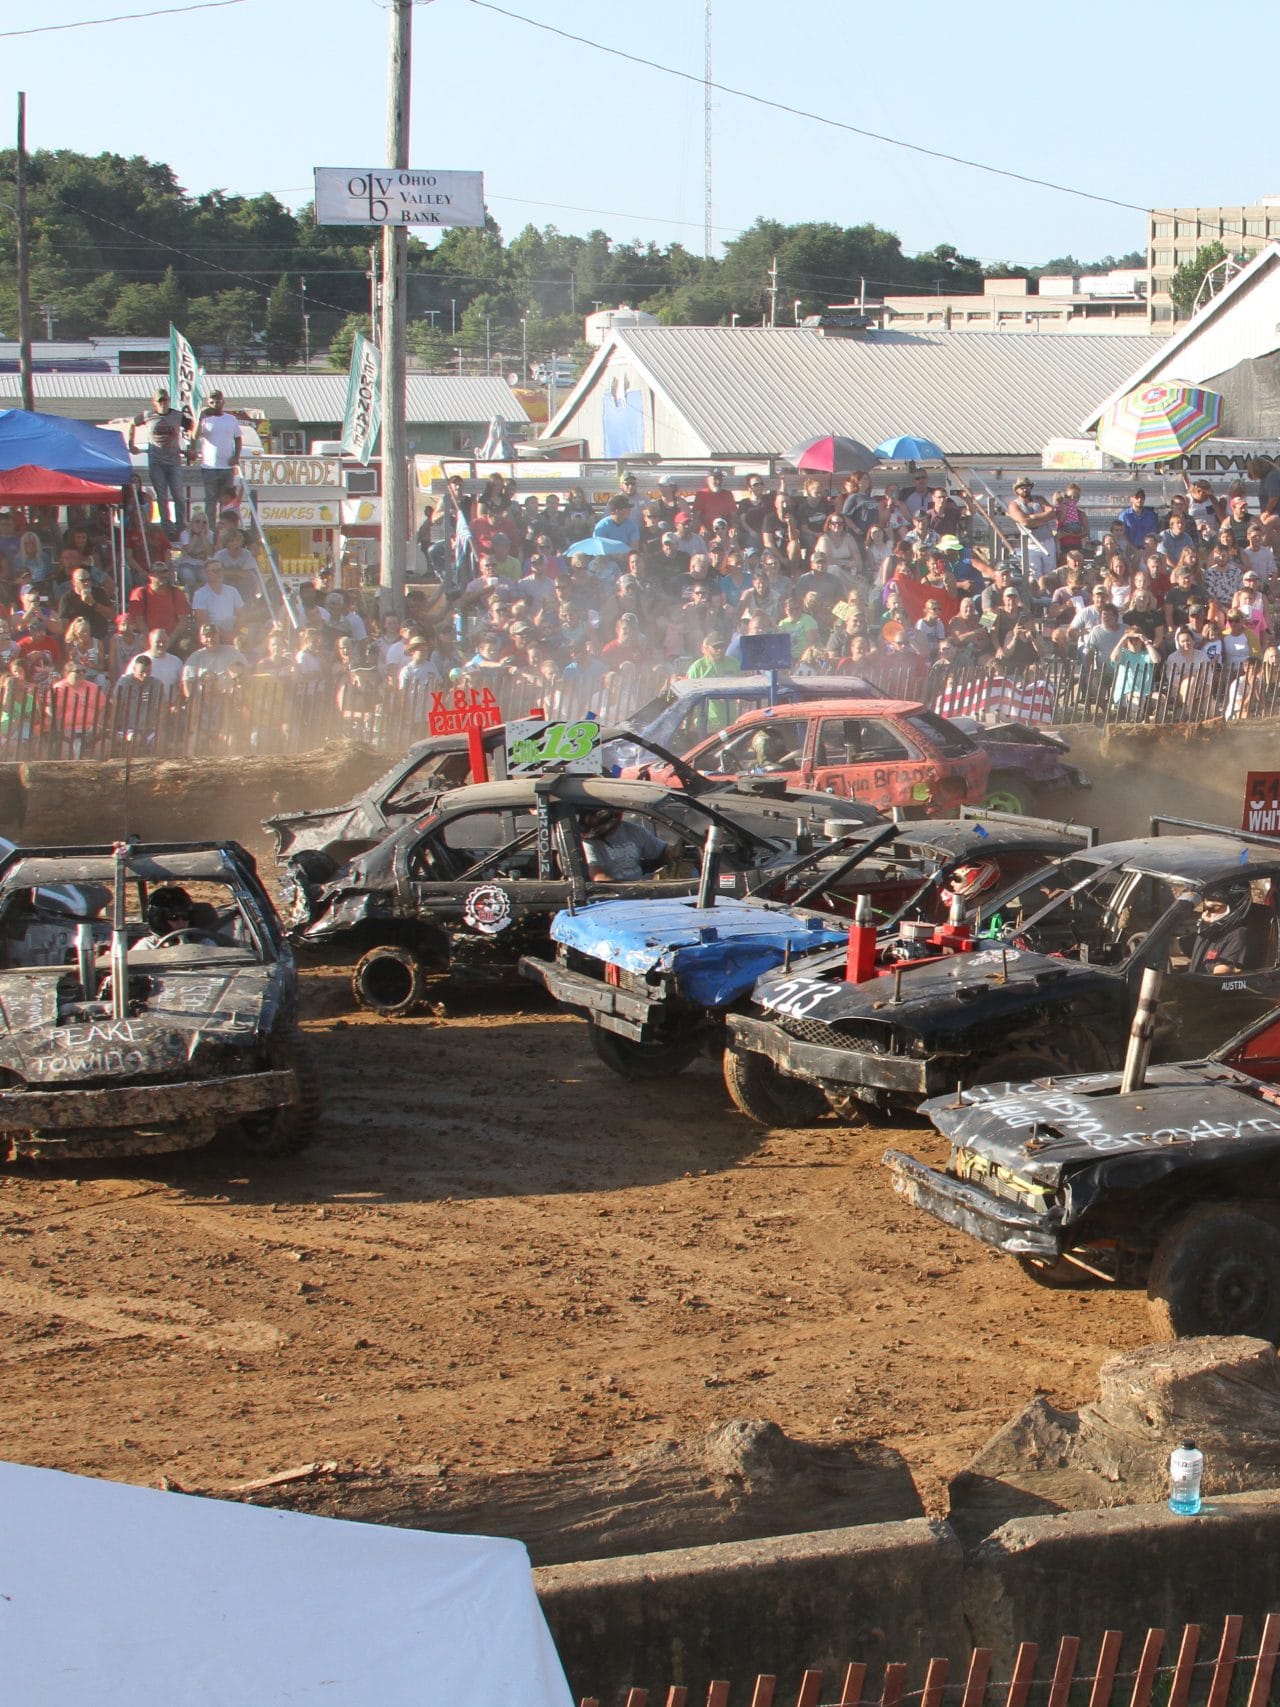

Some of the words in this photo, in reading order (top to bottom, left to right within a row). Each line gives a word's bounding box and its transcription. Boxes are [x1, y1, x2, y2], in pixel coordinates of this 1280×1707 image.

[261, 507, 315, 520] SHAKES
[536, 721, 600, 761] 13
[762, 977, 843, 1018] 513
[1221, 980, 1248, 991] AUSTIN
